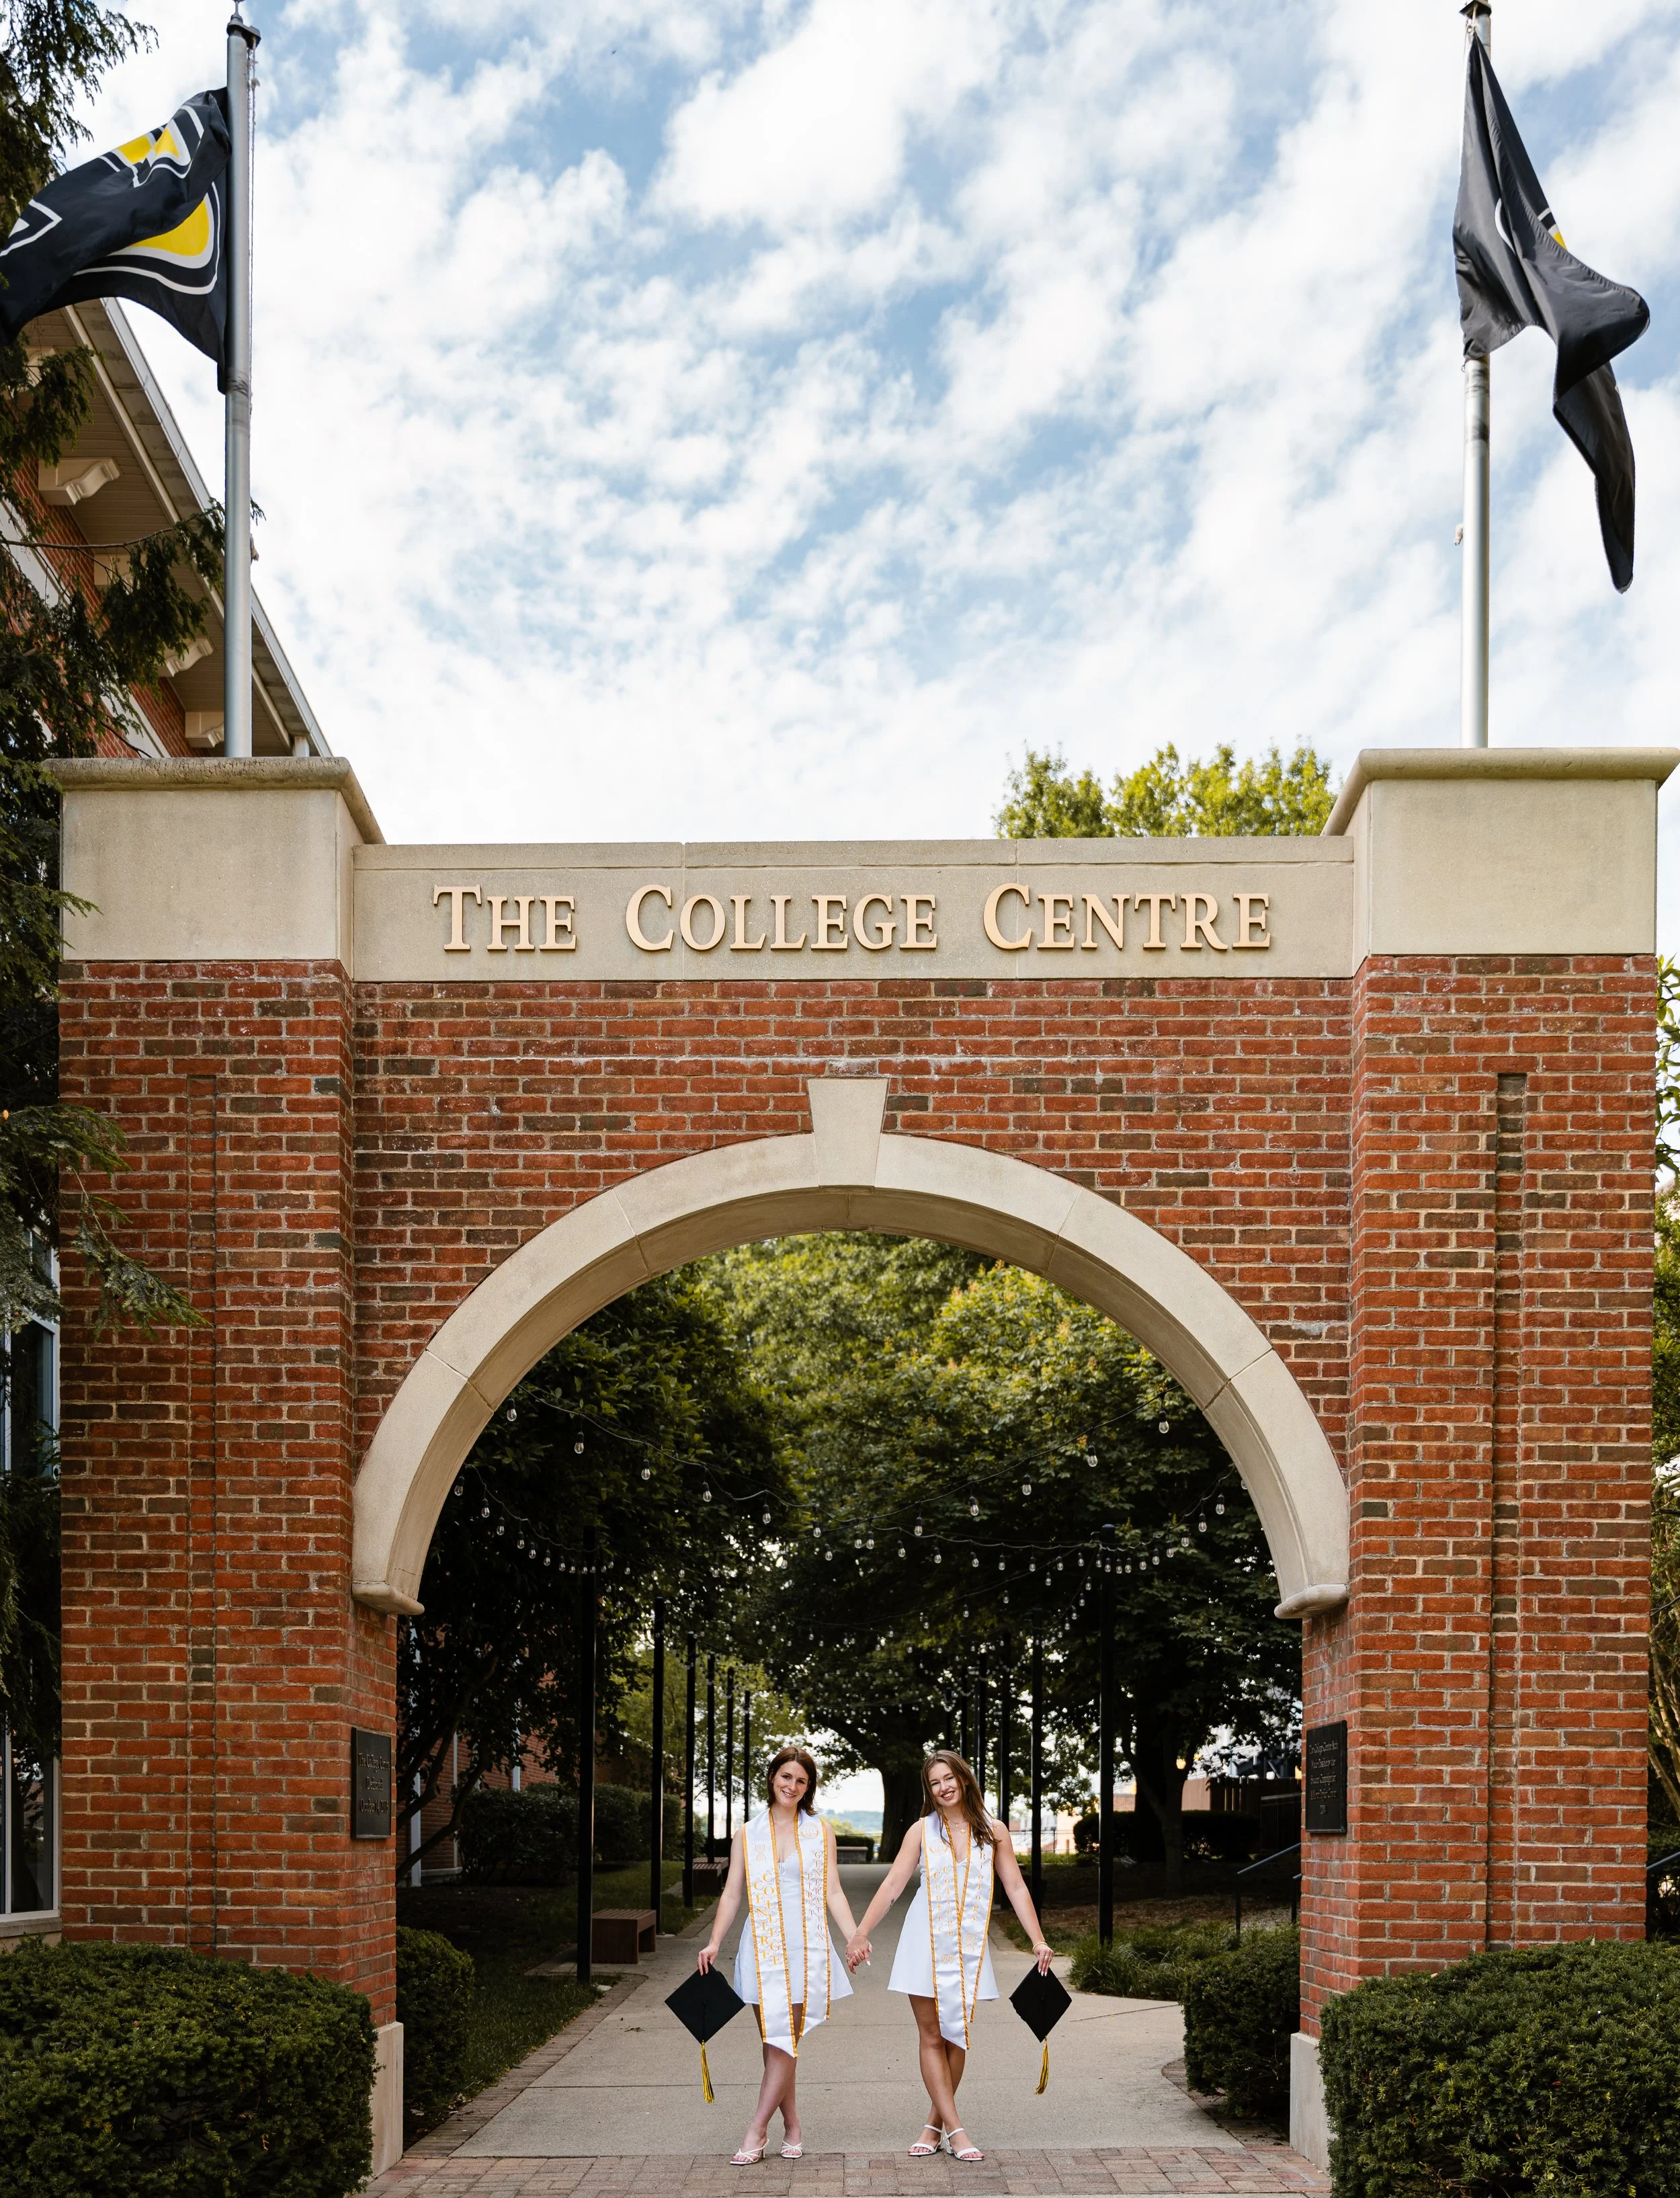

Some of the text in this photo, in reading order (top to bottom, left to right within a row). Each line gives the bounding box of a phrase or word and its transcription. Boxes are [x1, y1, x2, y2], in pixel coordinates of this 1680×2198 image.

[433, 882, 1271, 952] THE COLLEGE CENTRE
[754, 1880, 771, 1959] CENTRE
[763, 1871, 783, 1965] COLLEGE
[814, 1850, 825, 1941] GENERATION
[933, 1871, 943, 1932] Centre
[943, 1866, 954, 1937] College
